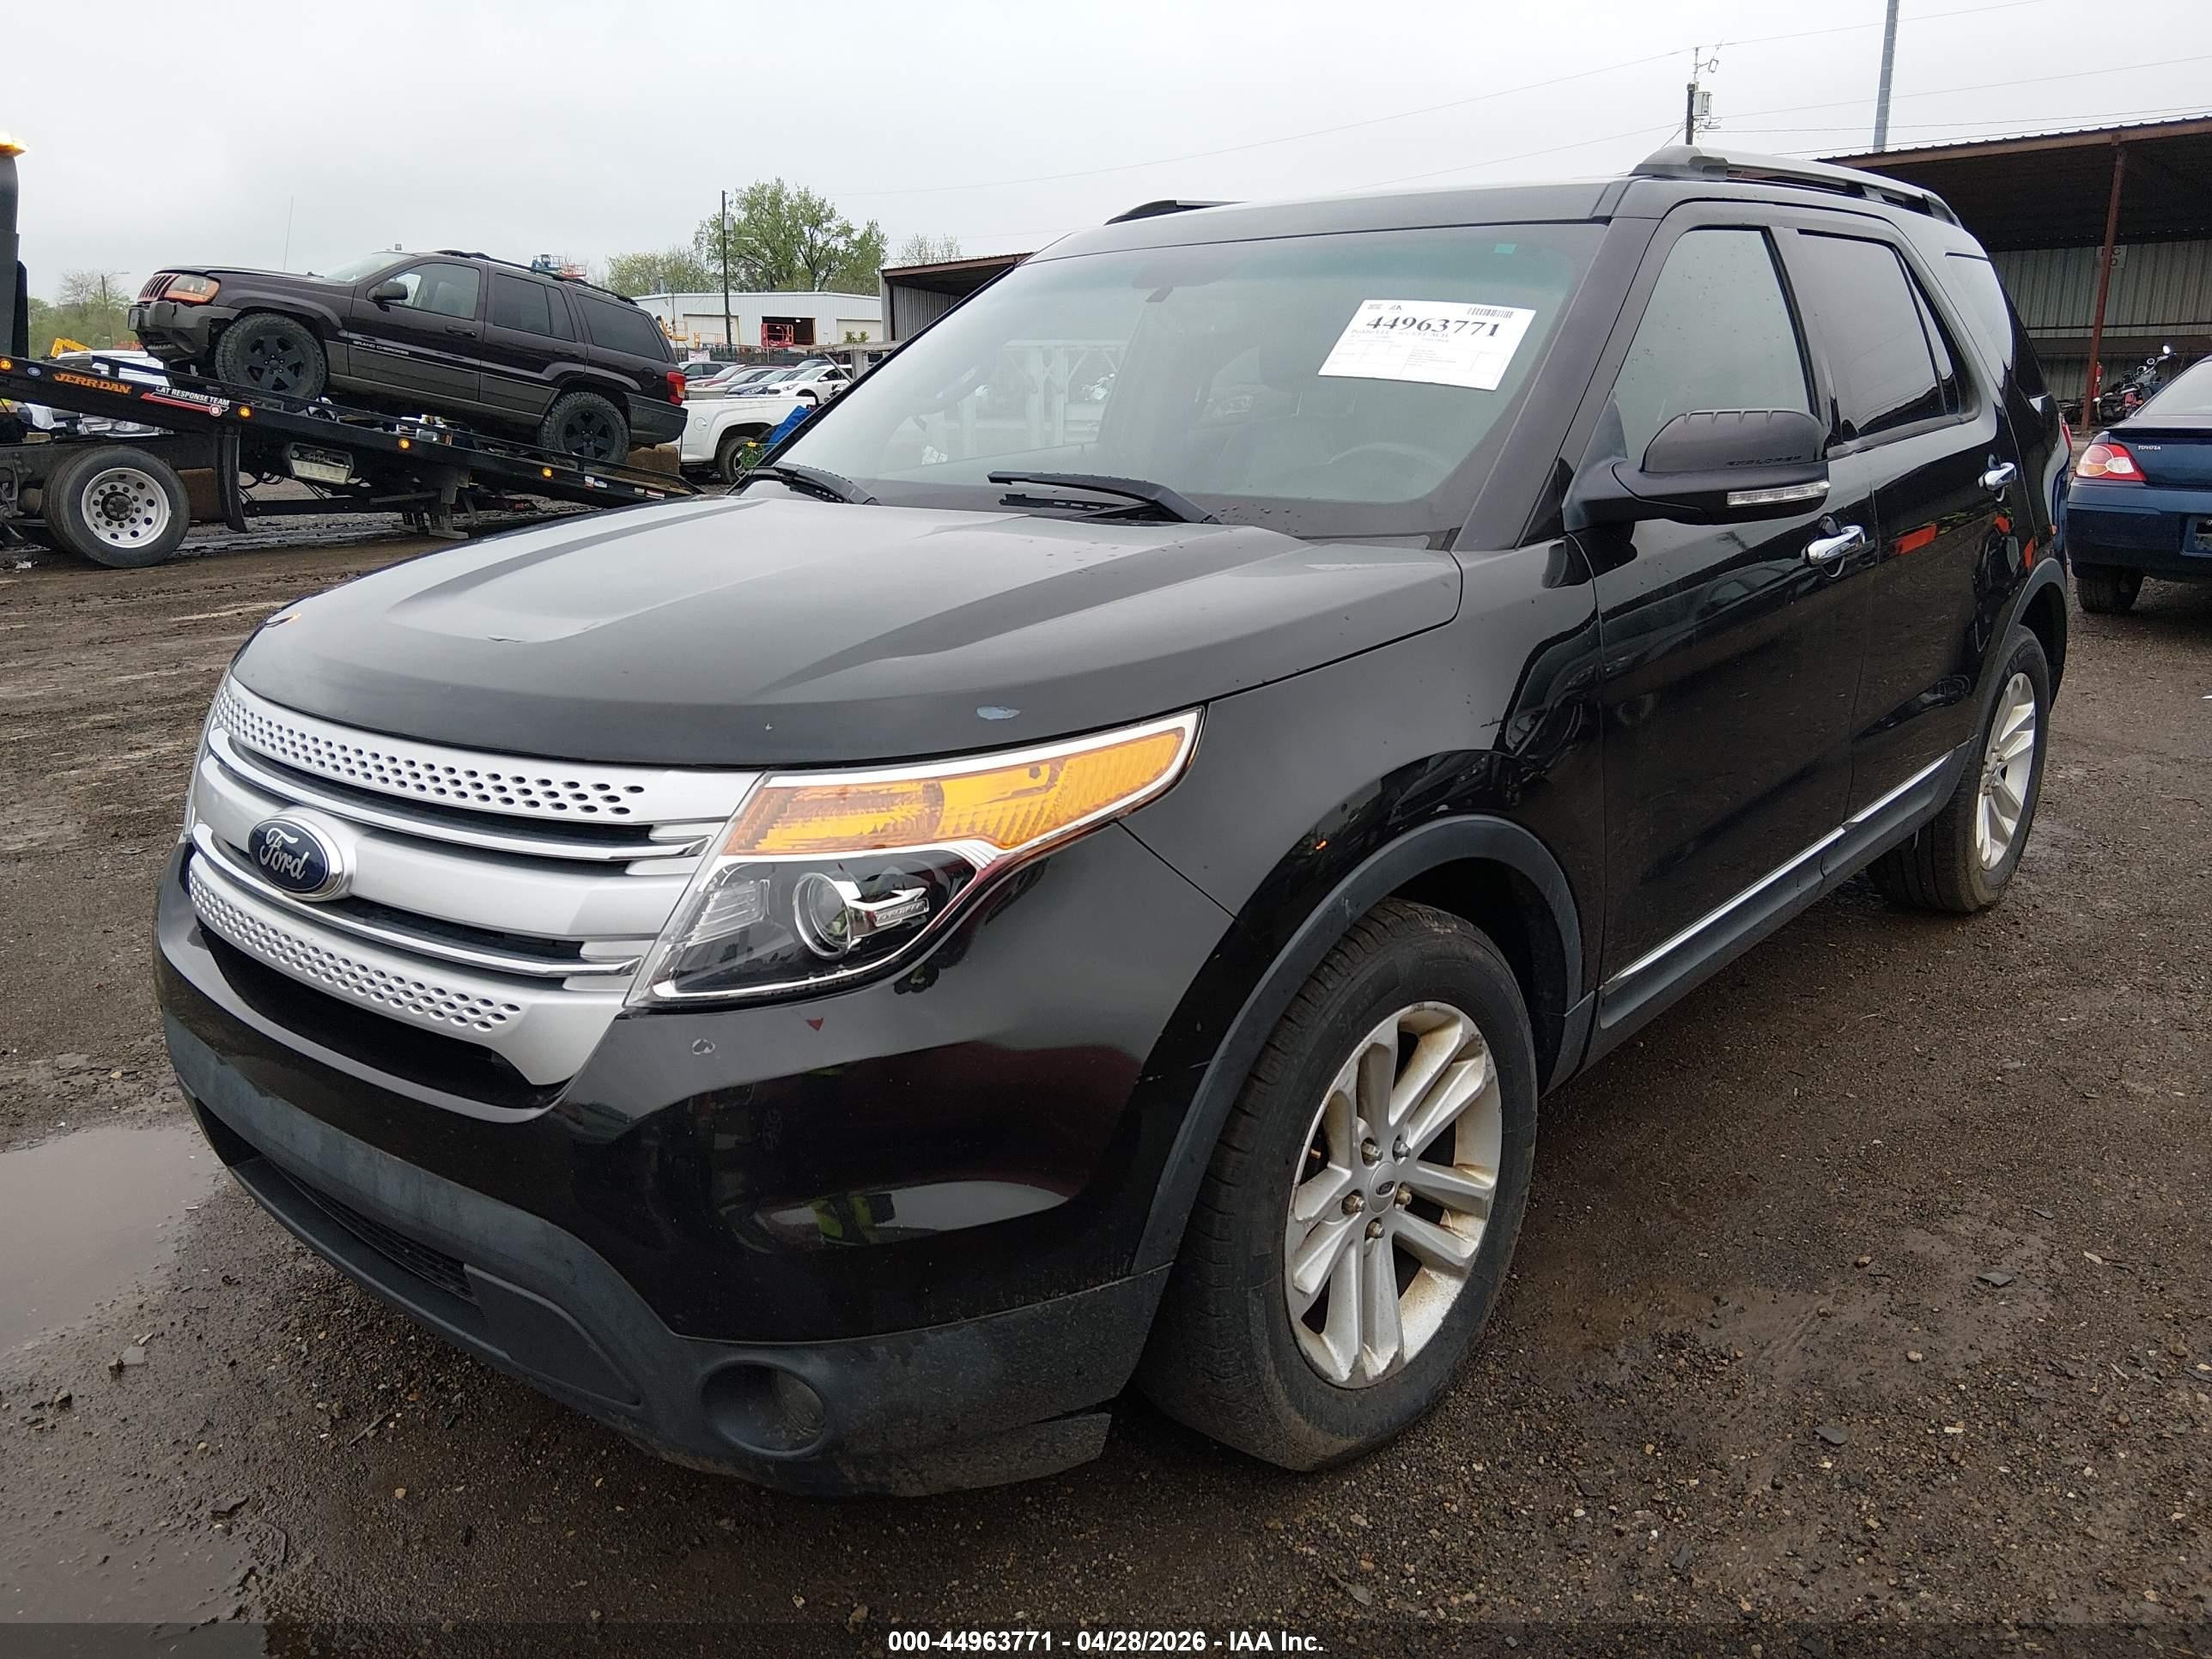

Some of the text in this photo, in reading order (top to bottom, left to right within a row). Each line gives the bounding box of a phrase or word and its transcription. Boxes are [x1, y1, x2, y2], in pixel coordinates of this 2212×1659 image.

[1366, 315, 1500, 337] 44963771
[172, 389, 207, 402] RESPONSE
[208, 396, 230, 406] TEAM
[259, 827, 309, 880] Ford
